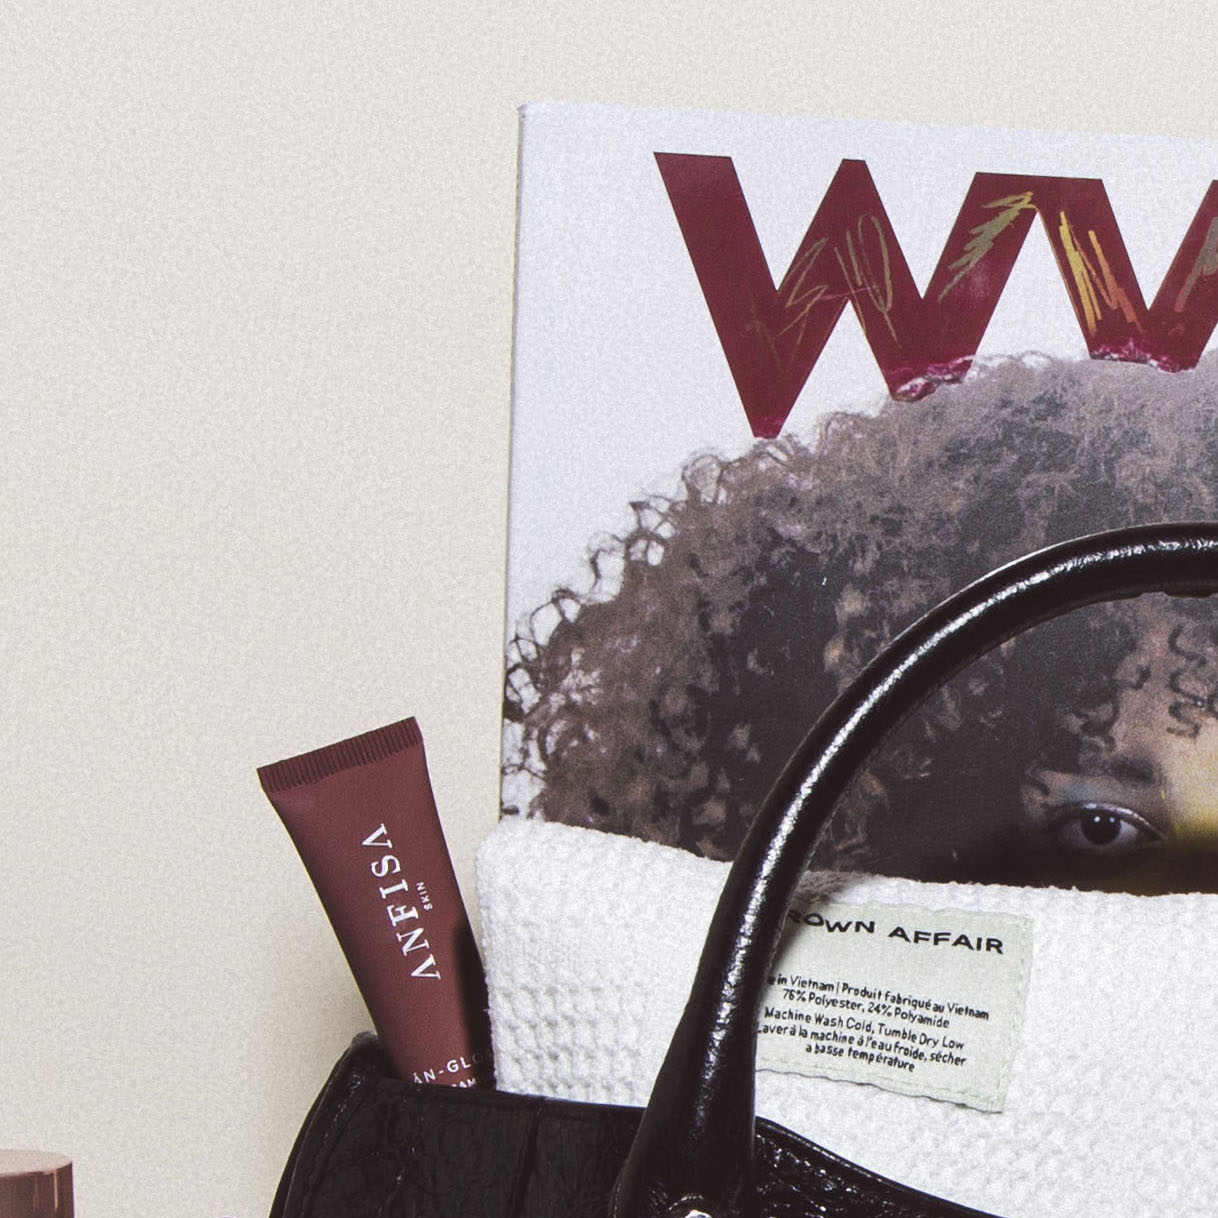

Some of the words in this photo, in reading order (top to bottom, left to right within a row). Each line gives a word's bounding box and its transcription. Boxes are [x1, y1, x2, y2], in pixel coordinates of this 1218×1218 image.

[416, 882, 433, 911] SKIN
[888, 926, 1004, 955] AFFAIR
[777, 974, 788, 985] in
[790, 975, 835, 992] Vietnam
[842, 982, 882, 1000] Produit
[932, 1002, 945, 1013] au
[947, 1002, 990, 1020] Vietnam
[782, 988, 807, 1002] 76%
[867, 1001, 893, 1017] 24%
[894, 1007, 950, 1028] Polyamide
[764, 1006, 812, 1024] Machine
[814, 1012, 844, 1028] Wash
[846, 1017, 875, 1035] Cold,
[878, 1023, 918, 1043] Tumble
[919, 1033, 940, 1048] Dry
[942, 1036, 965, 1051] Low
[810, 1029, 855, 1045] machine
